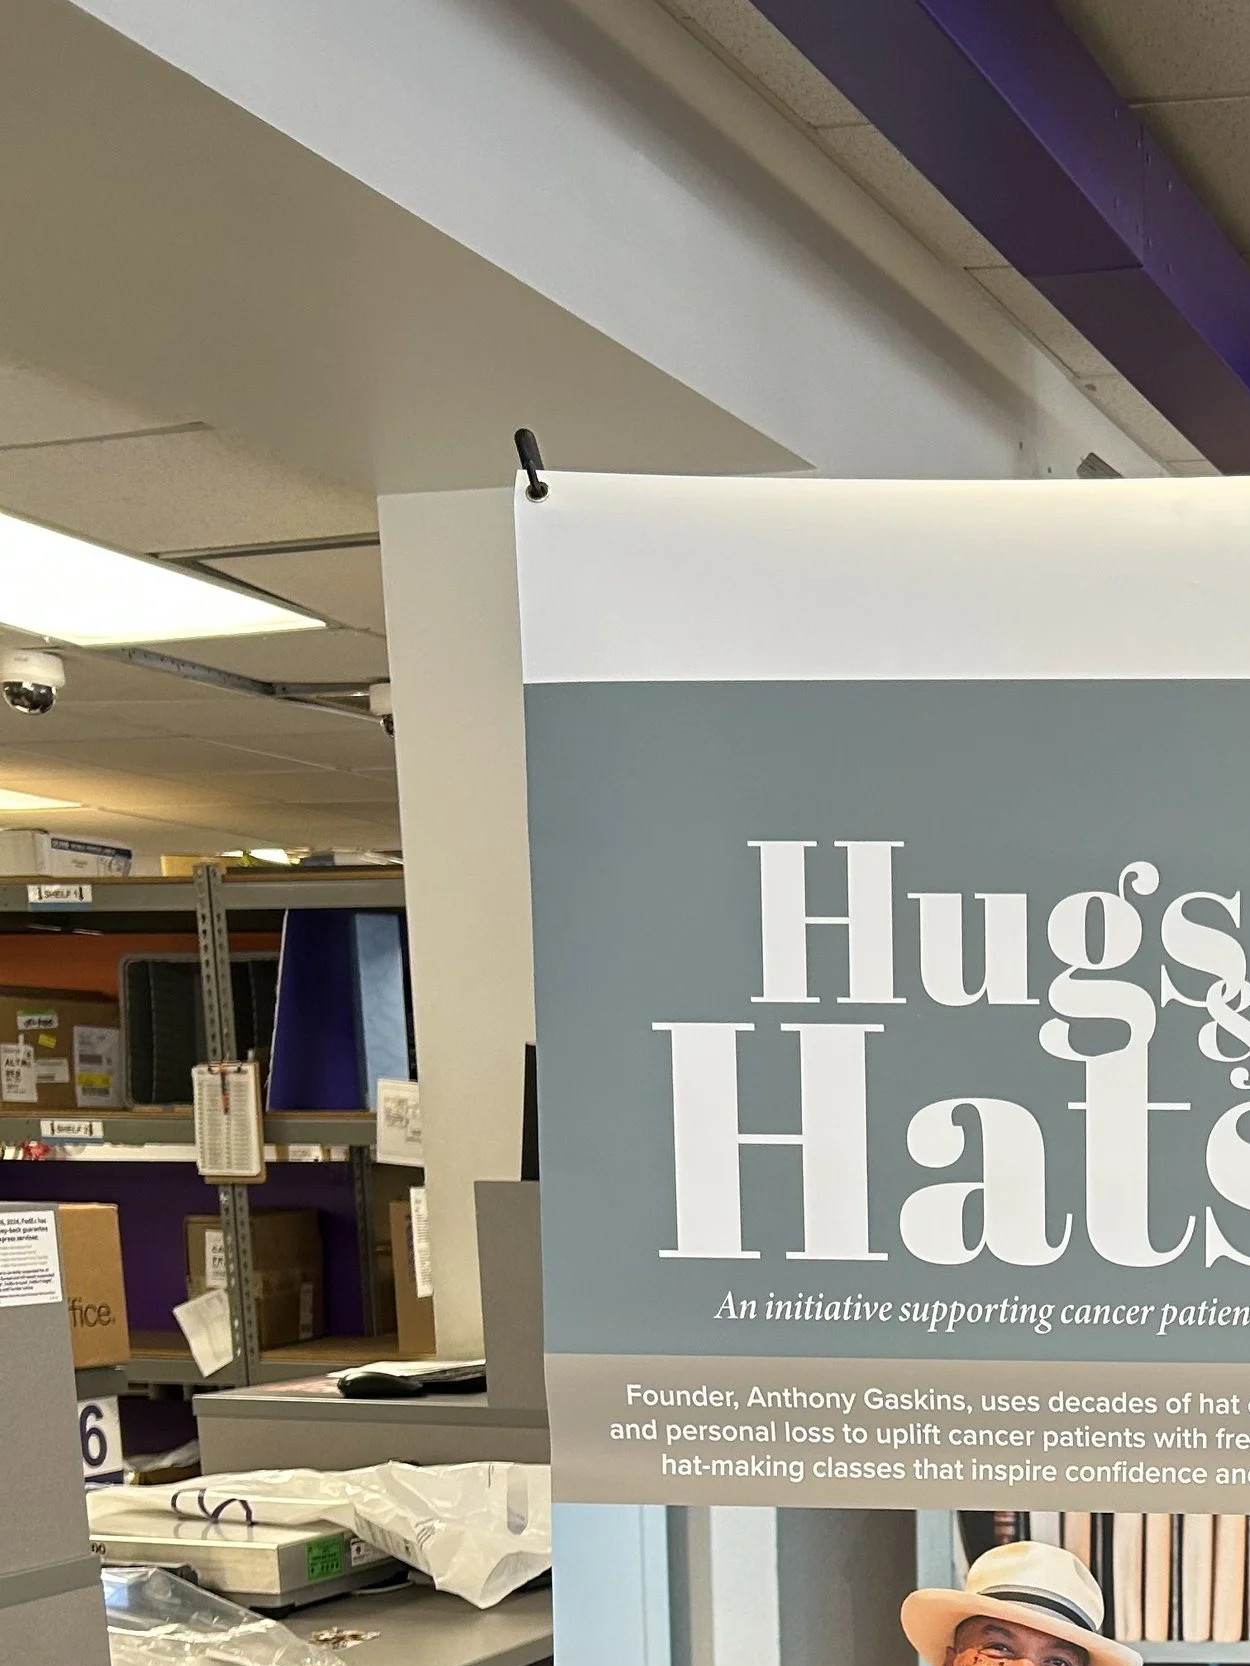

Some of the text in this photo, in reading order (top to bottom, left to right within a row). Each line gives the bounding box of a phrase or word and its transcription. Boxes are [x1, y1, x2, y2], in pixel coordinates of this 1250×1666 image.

[747, 840, 1248, 1061] Hugs
[712, 1290, 758, 1320] An
[765, 1291, 893, 1322] initiative
[898, 1295, 1056, 1335] supporting
[1060, 1304, 1155, 1326] cancer
[626, 1383, 739, 1411] Founder,
[746, 1386, 857, 1415] Anthony
[863, 1387, 973, 1415] Gaskins,
[981, 1394, 1041, 1412] uses
[1048, 1390, 1158, 1414] decades
[1165, 1392, 1193, 1414] of
[1199, 1392, 1241, 1415] hat
[79, 1405, 107, 1467] 6
[609, 1418, 658, 1441] and
[666, 1420, 777, 1446] personal
[784, 1421, 835, 1444] loss
[841, 1423, 868, 1444] to
[876, 1422, 941, 1450] uplift
[948, 1428, 1035, 1447] cancer
[1043, 1424, 1146, 1452] patients
[1153, 1426, 1207, 1449] with
[661, 1453, 804, 1483] hat-making
[812, 1456, 906, 1480] classes
[912, 1457, 964, 1481] that
[971, 1457, 1058, 1487] inspire
[1065, 1460, 1208, 1484] confidence
